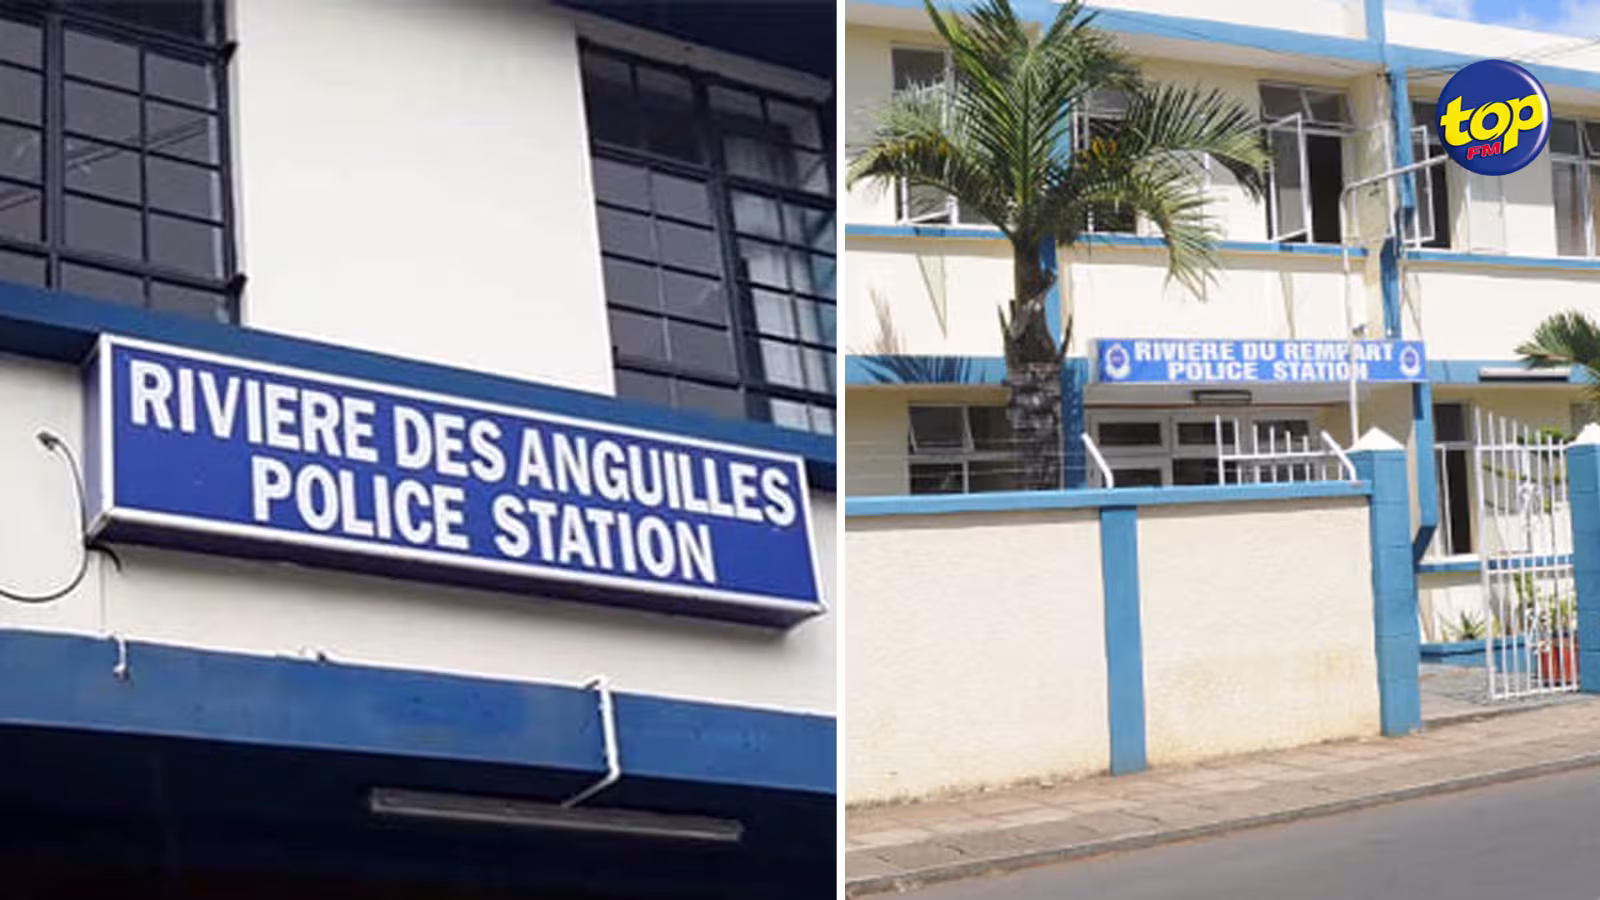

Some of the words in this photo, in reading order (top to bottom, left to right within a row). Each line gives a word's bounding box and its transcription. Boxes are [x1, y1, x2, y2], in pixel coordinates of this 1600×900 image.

[1133, 342, 1235, 361] RIVIERE
[1242, 343, 1277, 361] DU
[1167, 363, 1258, 381] POLICE
[129, 358, 379, 464] RIVIERE
[393, 405, 506, 483] DES
[516, 429, 798, 527] ANGUILLES
[250, 456, 471, 550] POLICE
[494, 494, 716, 583] STATION
